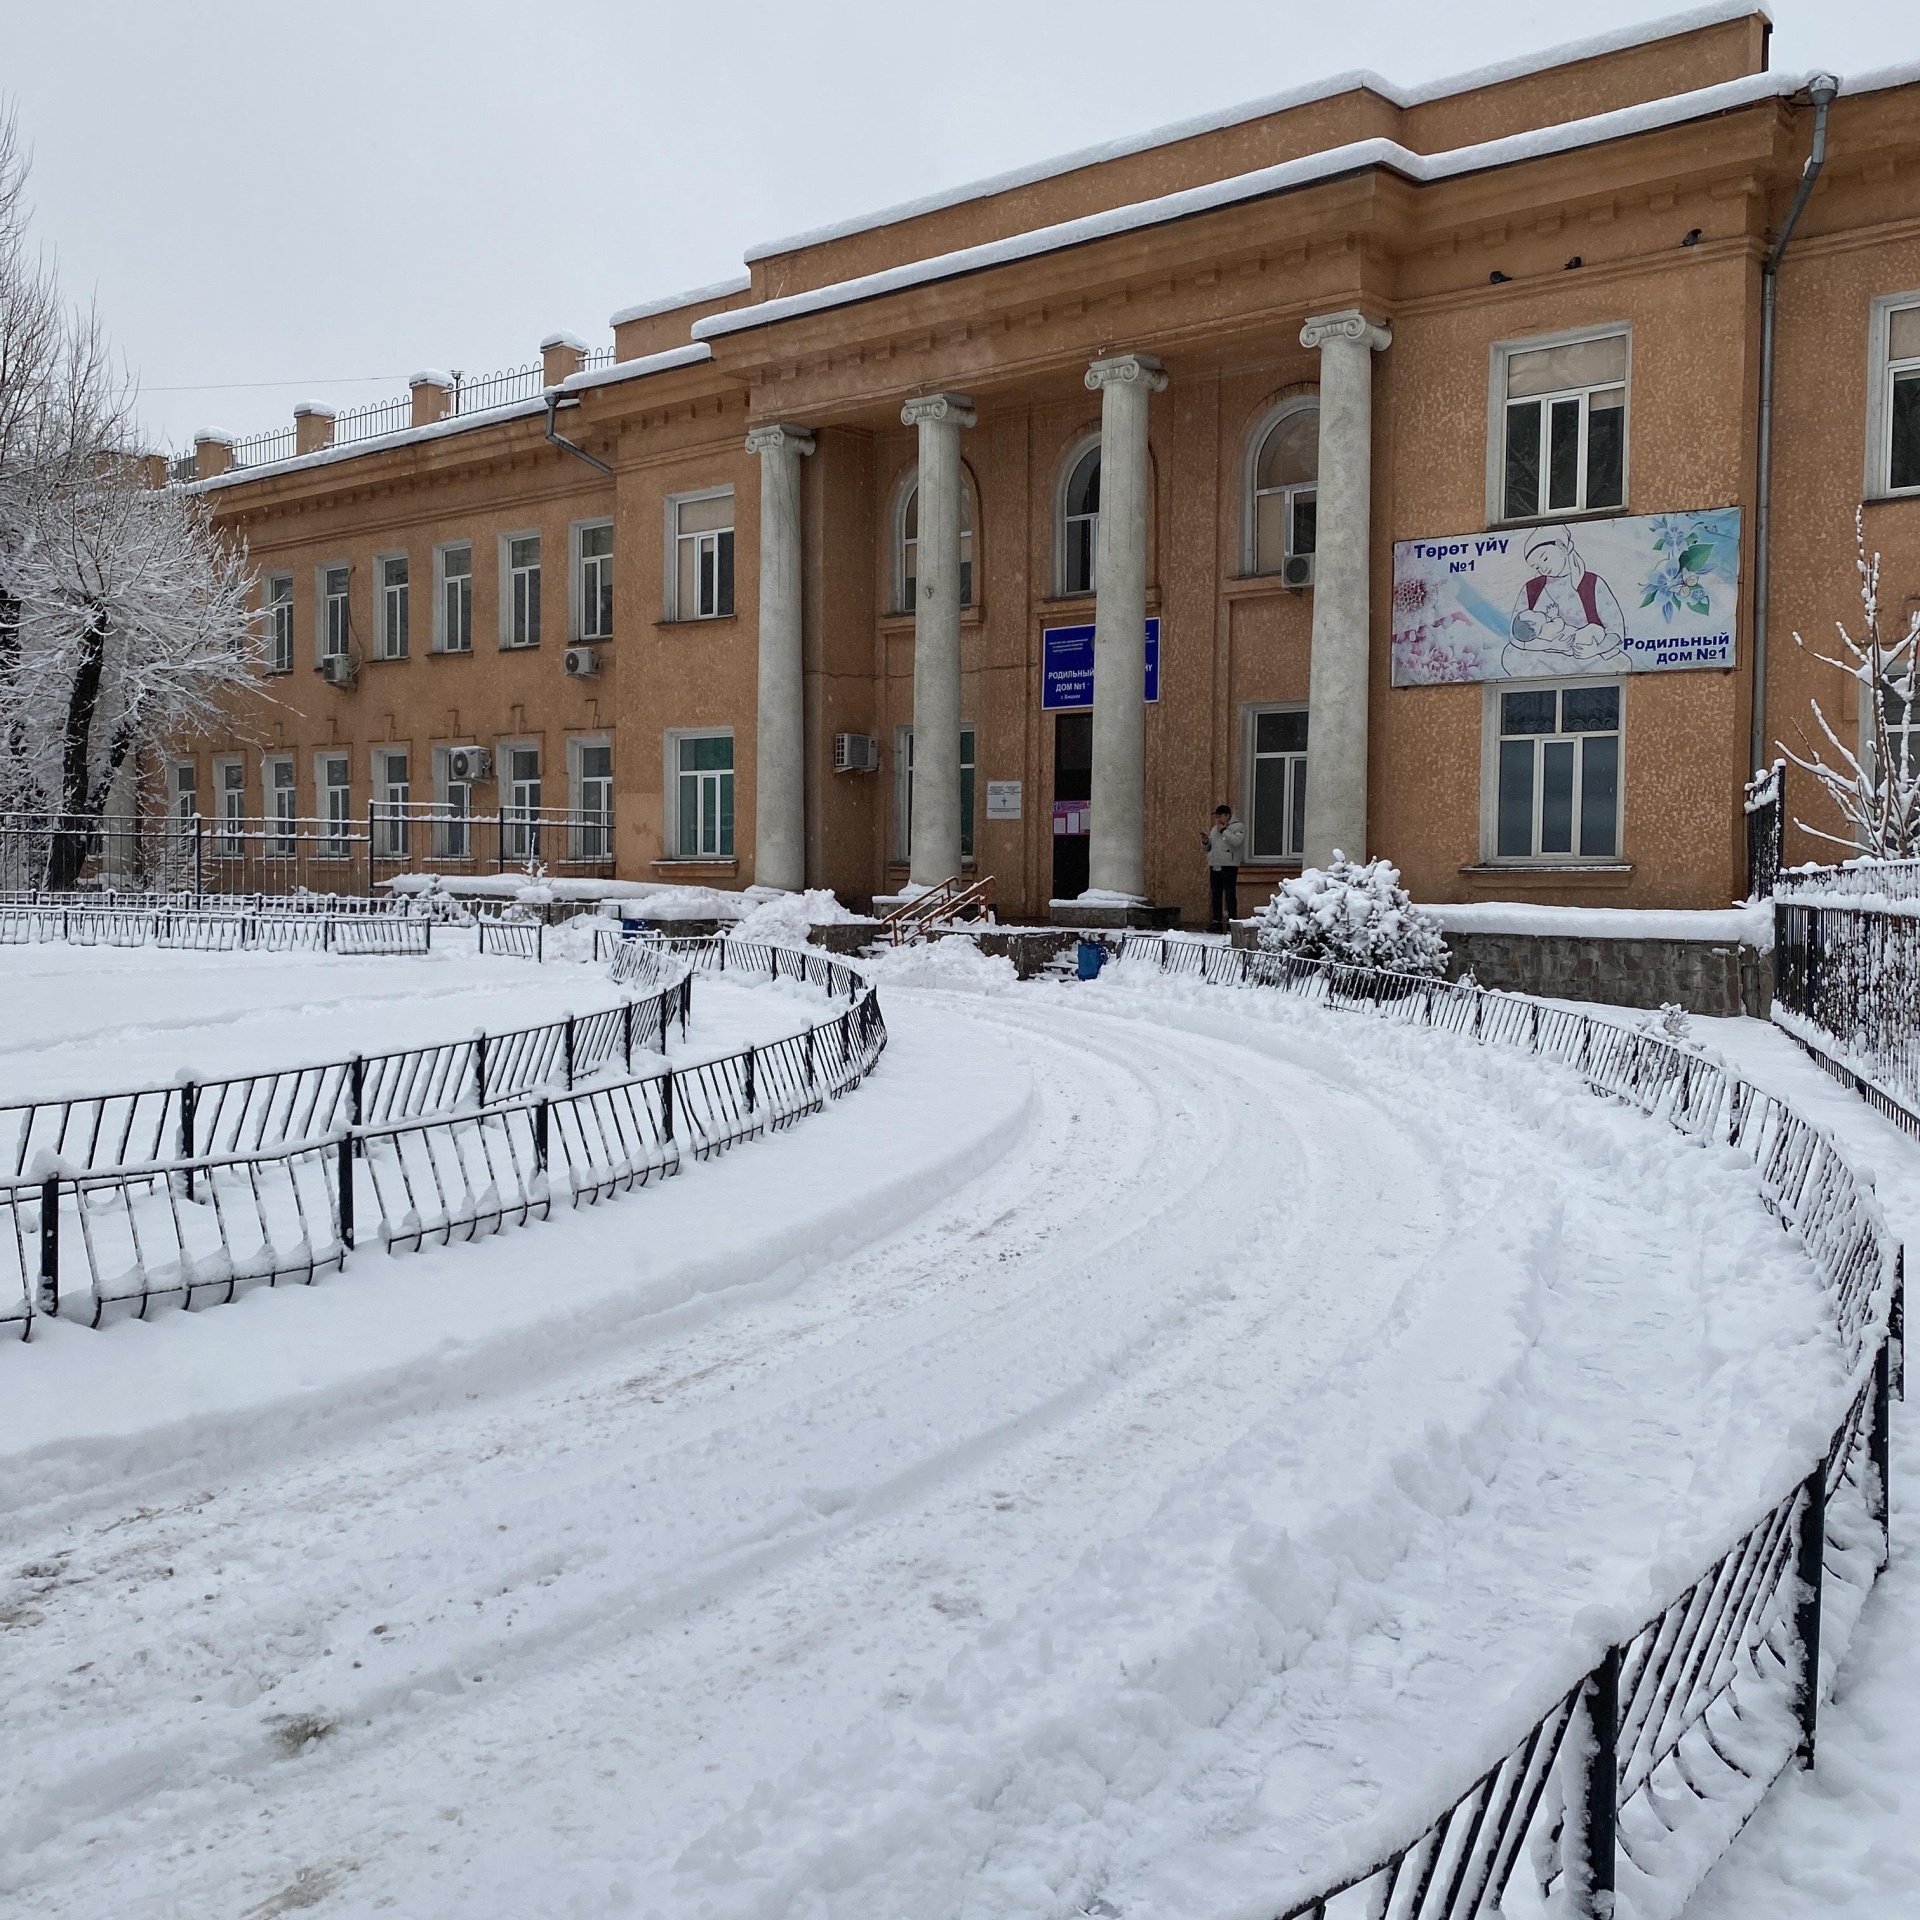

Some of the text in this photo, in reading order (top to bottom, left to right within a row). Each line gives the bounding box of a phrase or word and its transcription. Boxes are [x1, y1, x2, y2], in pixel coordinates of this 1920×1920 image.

[1414, 536, 1509, 560] Төрөт үйү
[1449, 559, 1475, 573] №1
[1623, 631, 1730, 651] Родильный
[1656, 647, 1727, 665] дом №1
[1055, 682, 1086, 693] ДОМ №1
